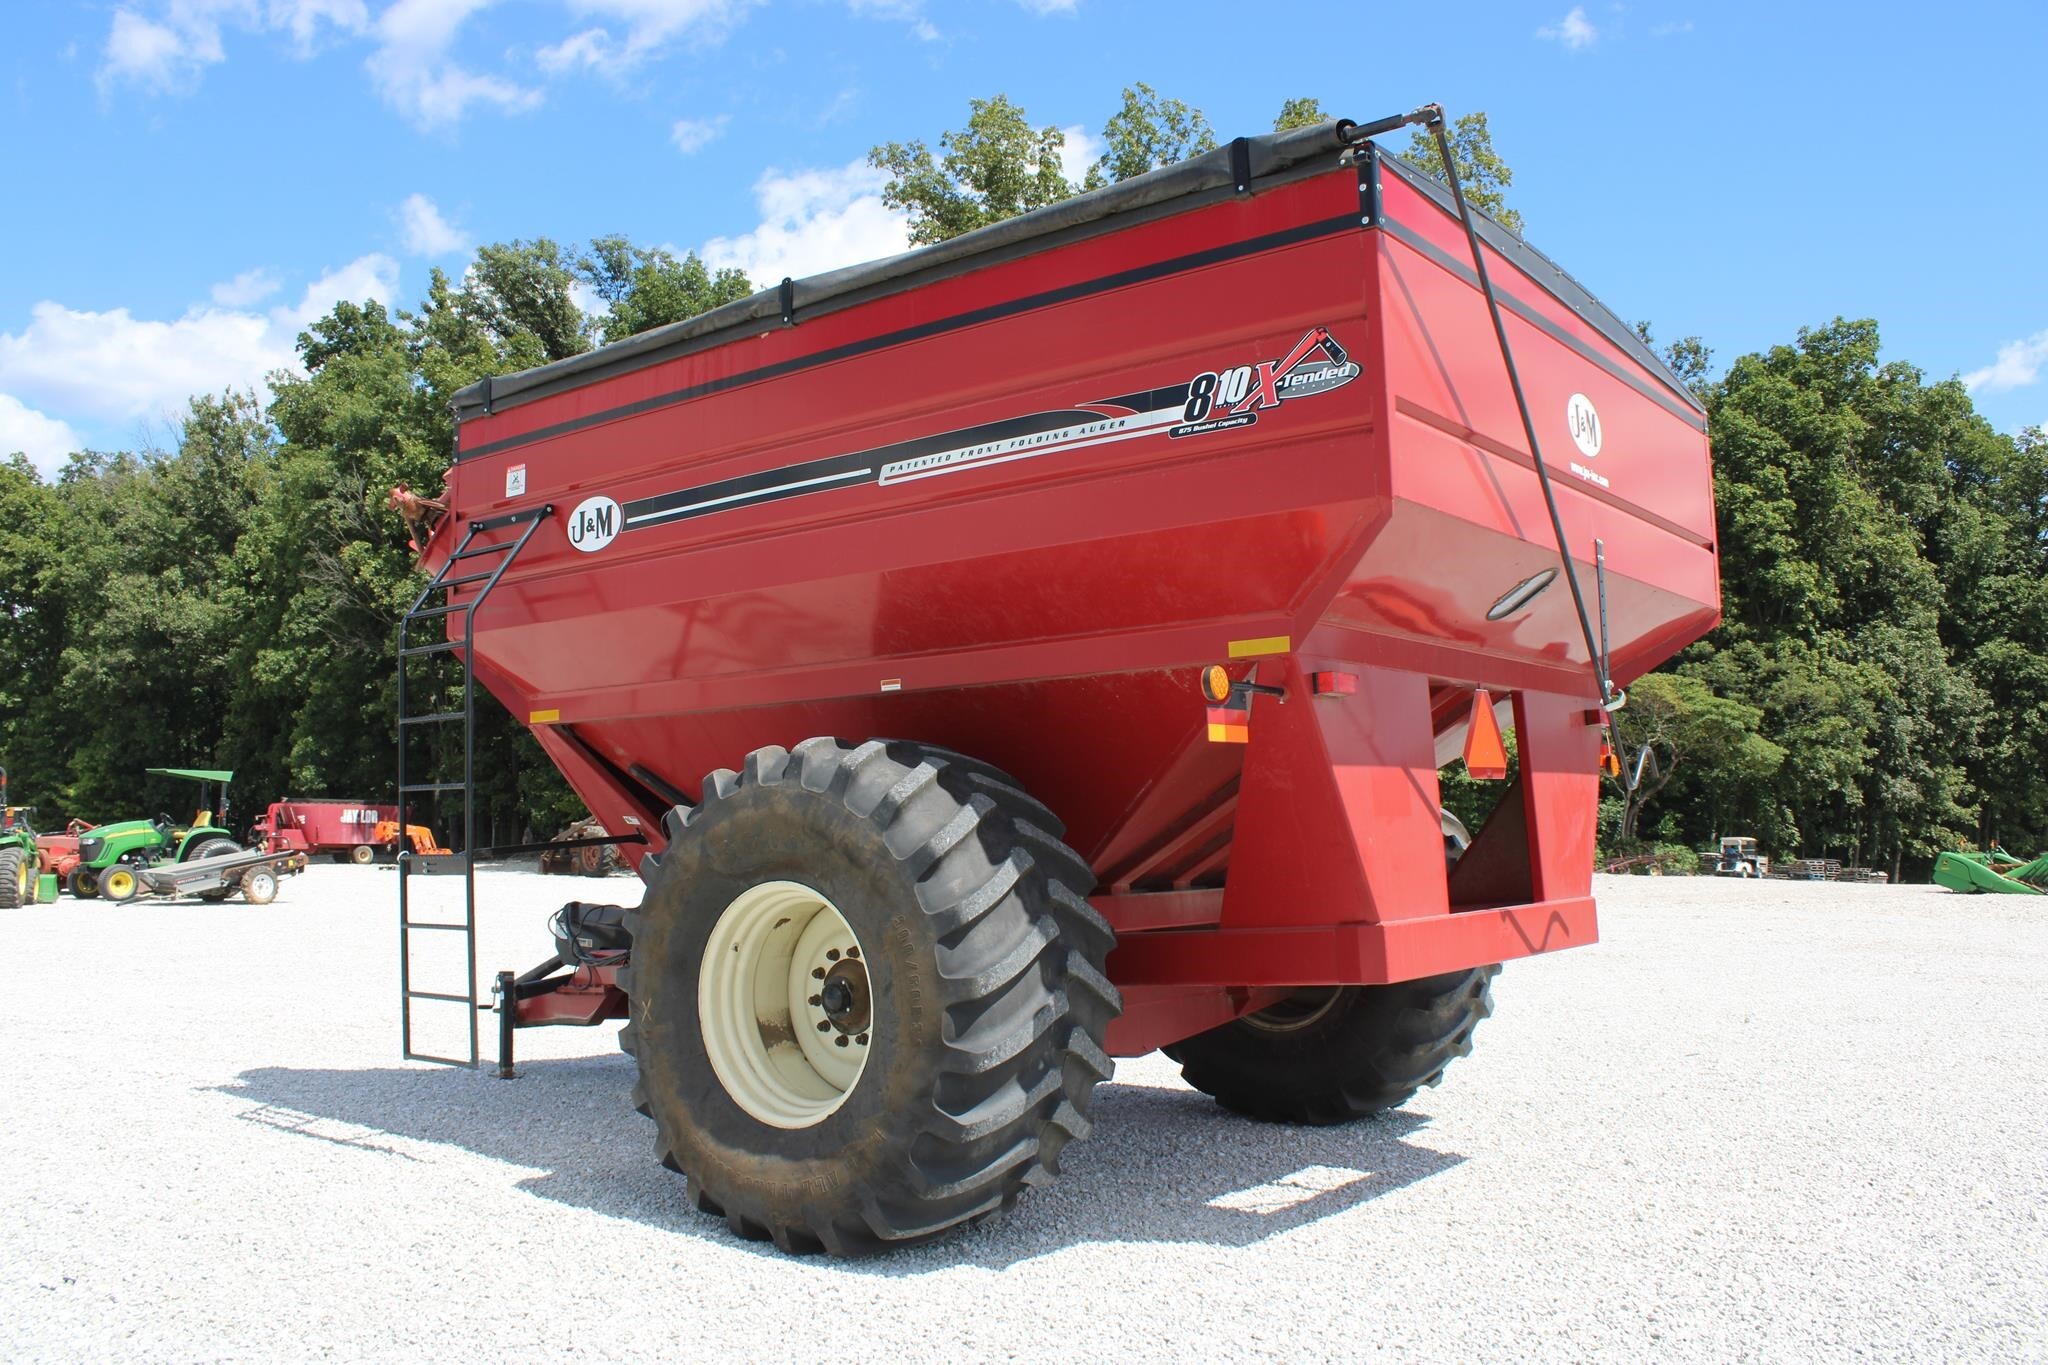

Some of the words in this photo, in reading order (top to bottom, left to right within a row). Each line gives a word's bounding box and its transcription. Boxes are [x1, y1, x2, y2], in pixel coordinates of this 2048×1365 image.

[1193, 422, 1217, 432] Bushel
[1218, 416, 1249, 427] Capacity
[1571, 403, 1598, 448] J&M
[889, 454, 952, 473] PATENTED
[960, 443, 1002, 459] FRONT
[1010, 430, 1069, 449] FOLDING
[1079, 419, 1126, 435] AUGER
[571, 504, 614, 544] J&M
